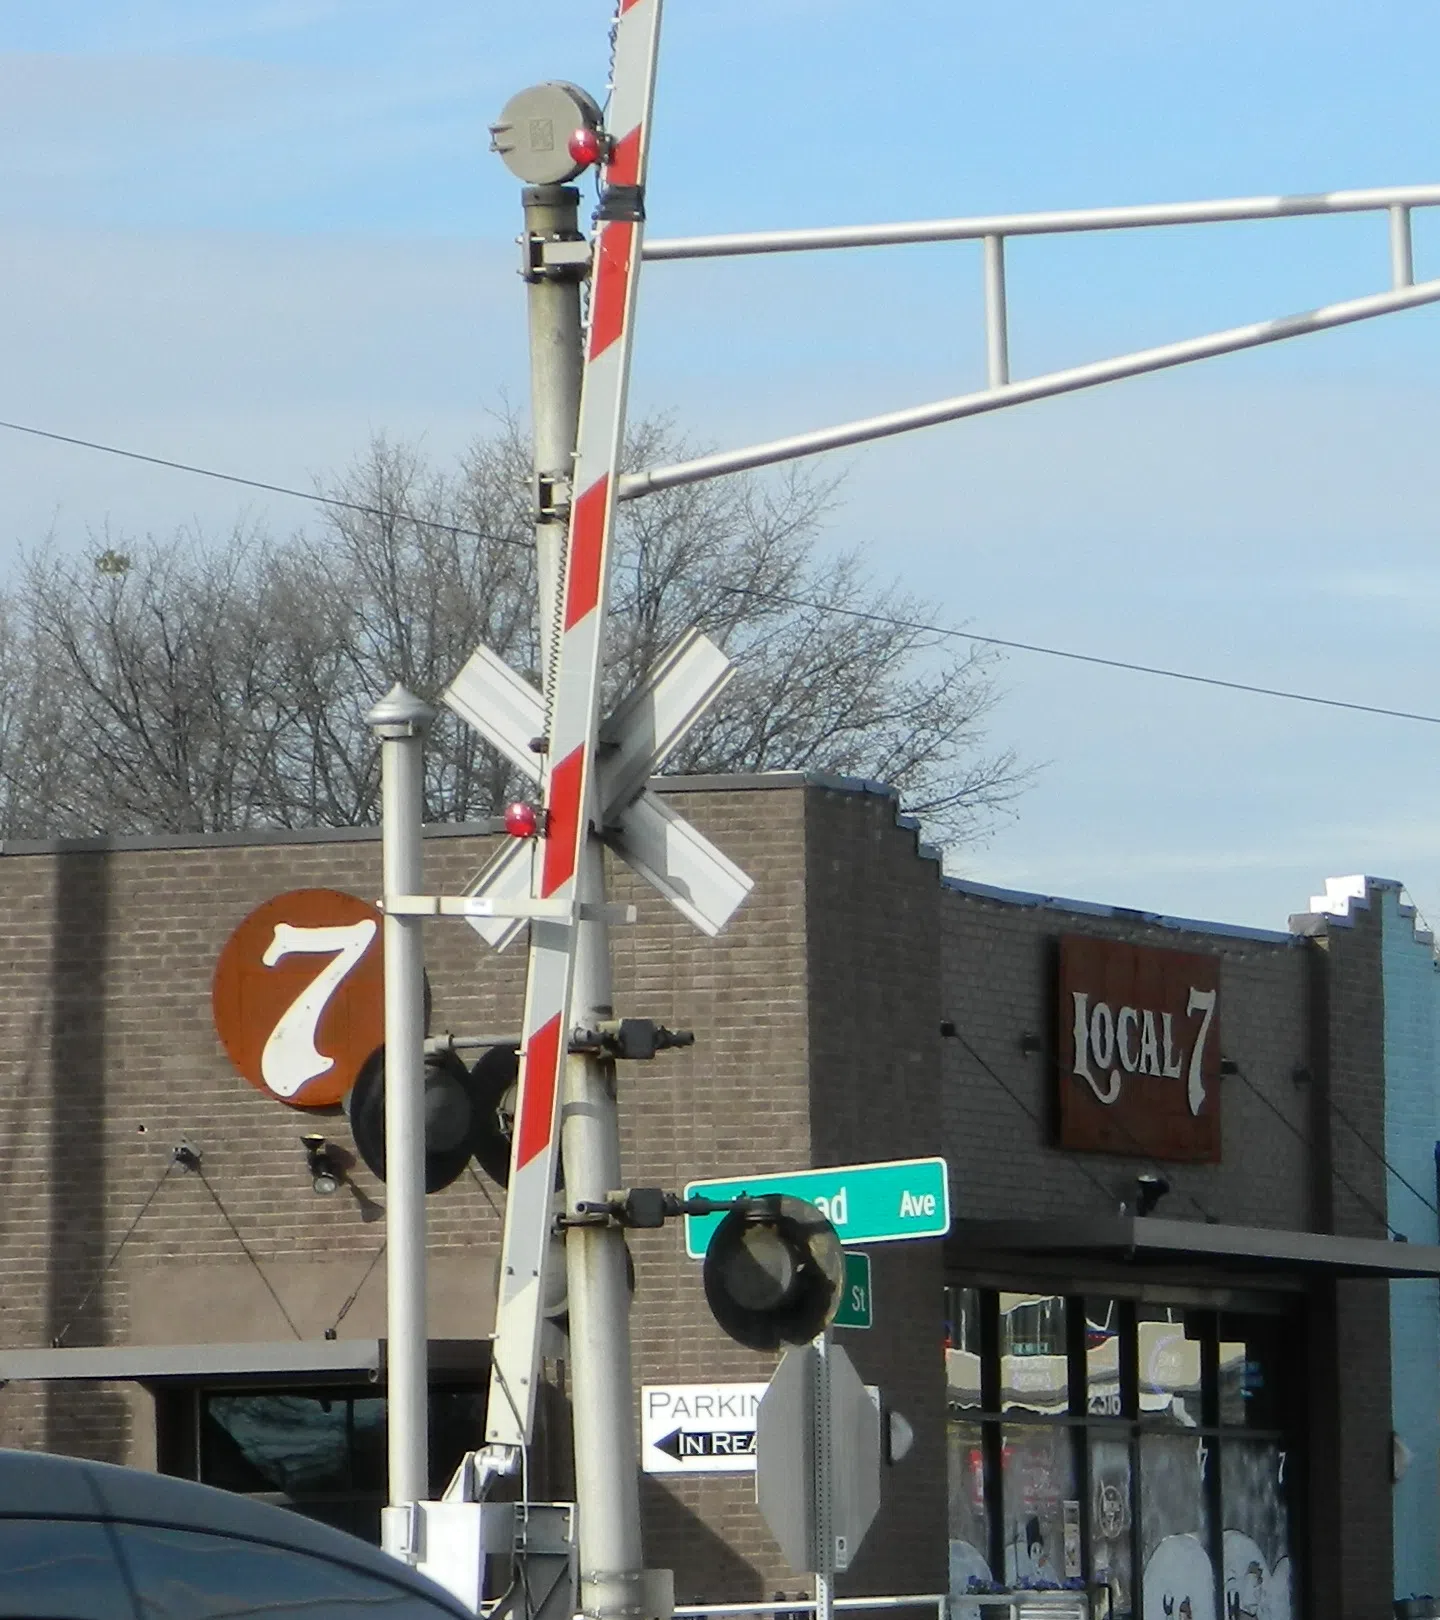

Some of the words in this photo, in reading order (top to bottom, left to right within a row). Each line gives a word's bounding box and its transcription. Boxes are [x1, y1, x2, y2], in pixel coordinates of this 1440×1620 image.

[261, 918, 377, 1098] 7
[1072, 991, 1183, 1105] LOCAL
[1186, 986, 1217, 1117] 7
[899, 1189, 936, 1218] Ave
[851, 1286, 867, 1312] St
[648, 1391, 763, 1419] PARKIN
[678, 1433, 704, 1456] IN
[711, 1431, 758, 1454] REA
